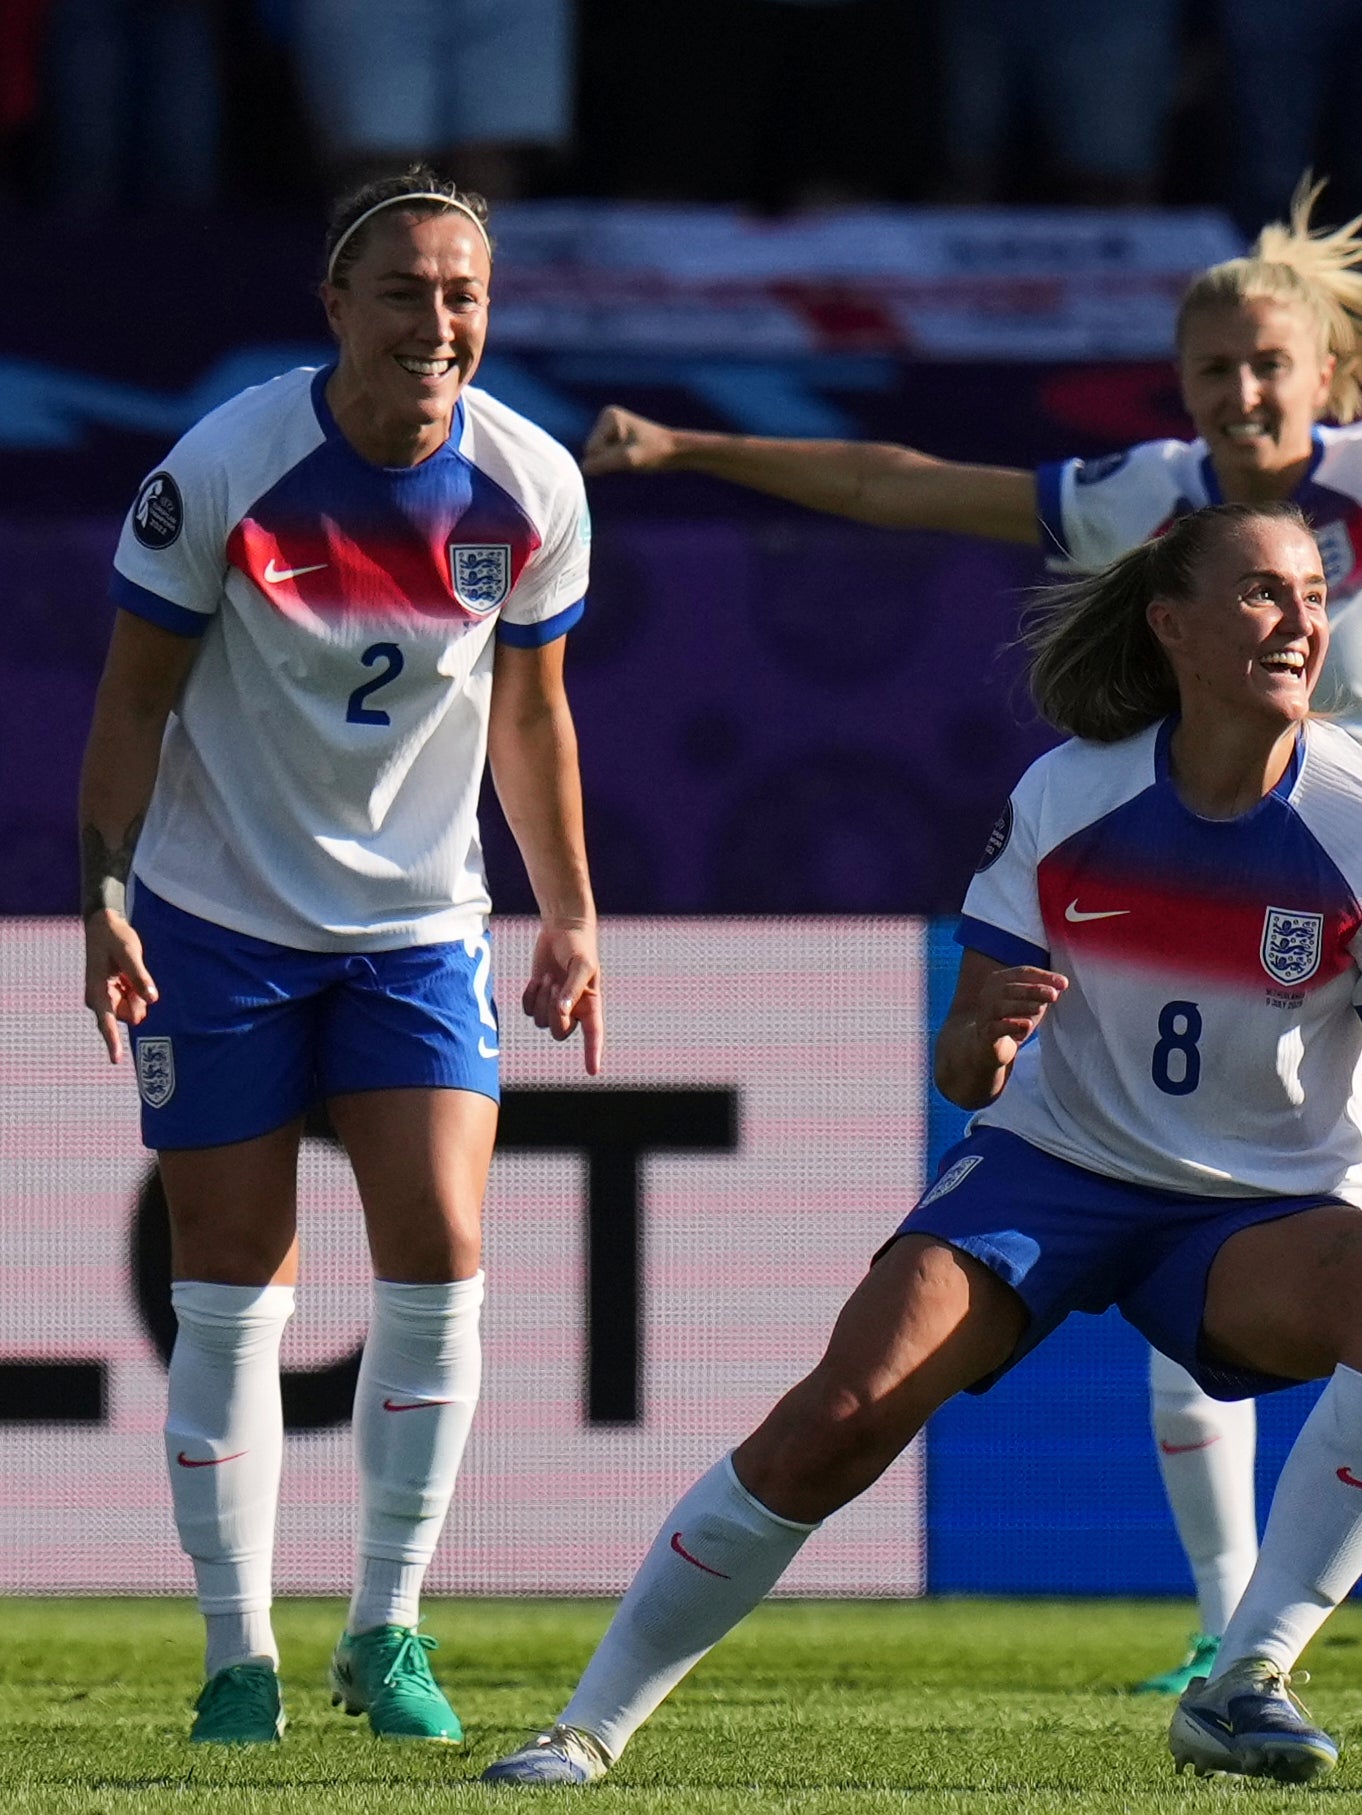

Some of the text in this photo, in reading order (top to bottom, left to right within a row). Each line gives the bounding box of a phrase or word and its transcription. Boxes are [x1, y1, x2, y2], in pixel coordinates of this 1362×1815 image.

[345, 641, 405, 726] 2
[463, 935, 499, 1032] 2
[1150, 999, 1203, 1096] 8
